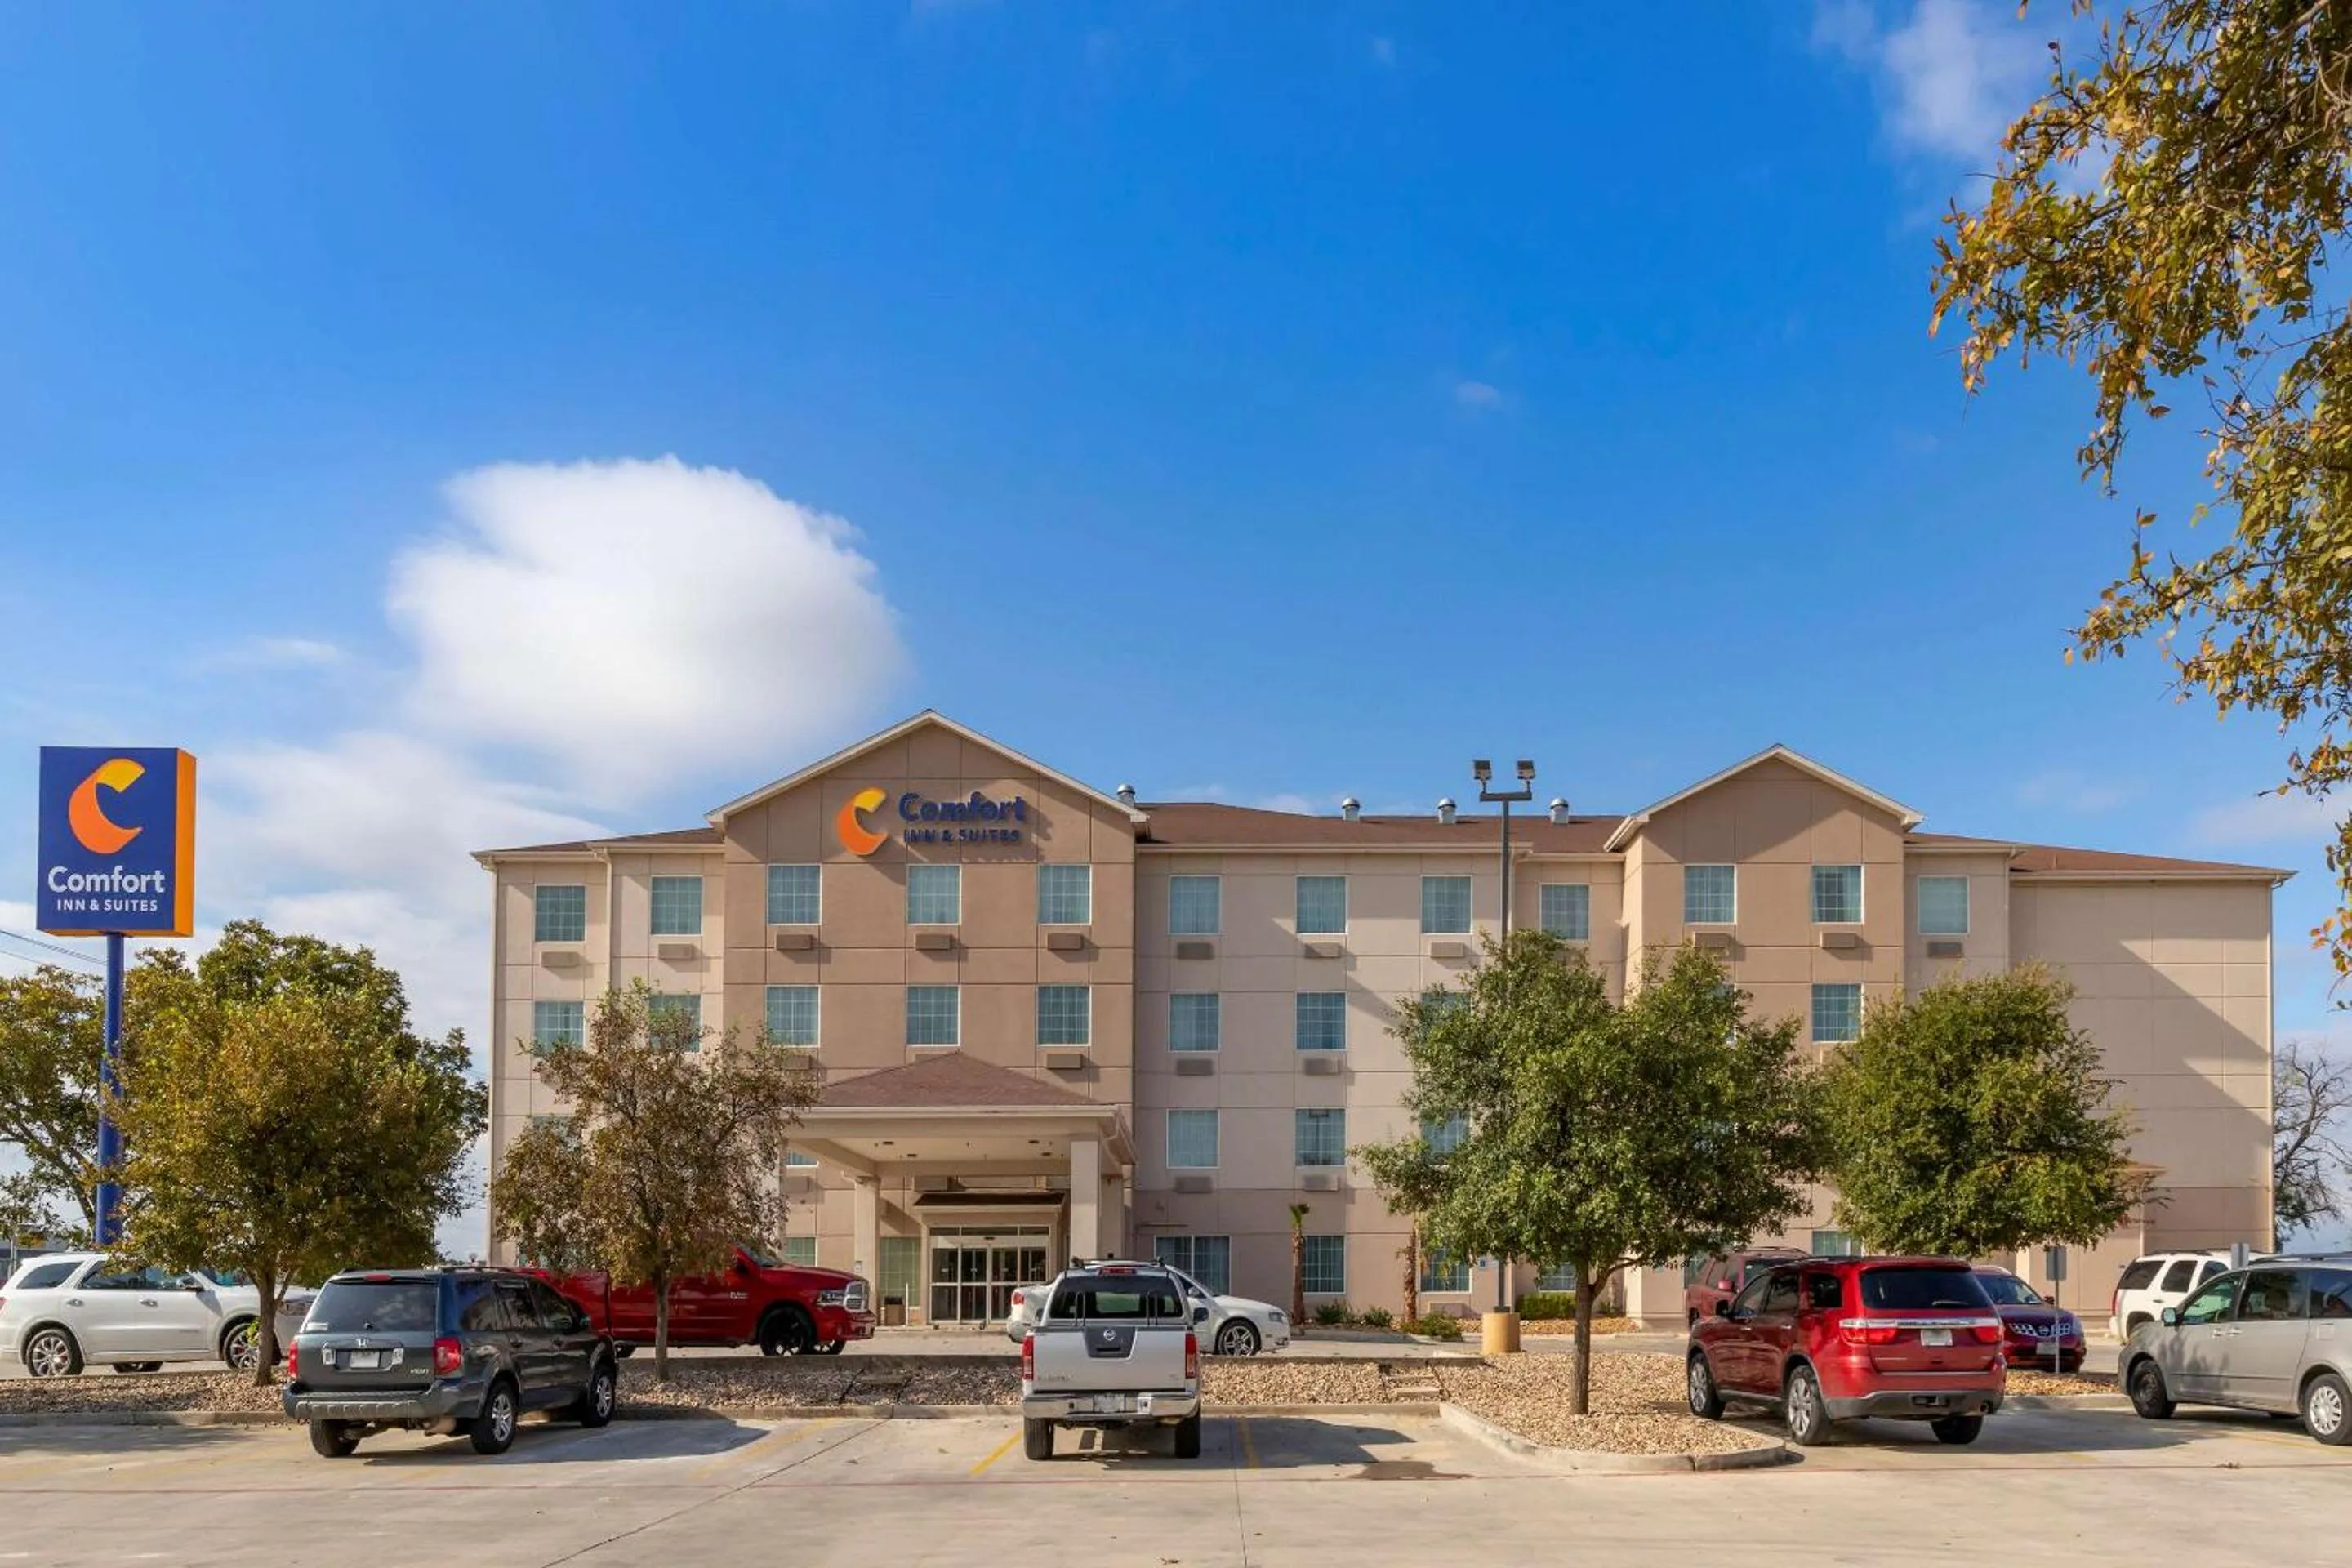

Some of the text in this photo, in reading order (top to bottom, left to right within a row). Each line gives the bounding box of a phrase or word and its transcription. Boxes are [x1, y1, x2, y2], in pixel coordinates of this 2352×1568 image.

[899, 791, 1027, 822] Comfort
[903, 828, 1021, 845] INN & SUITES
[47, 865, 166, 893] Comfort
[57, 899, 158, 912] INN & SUITES
